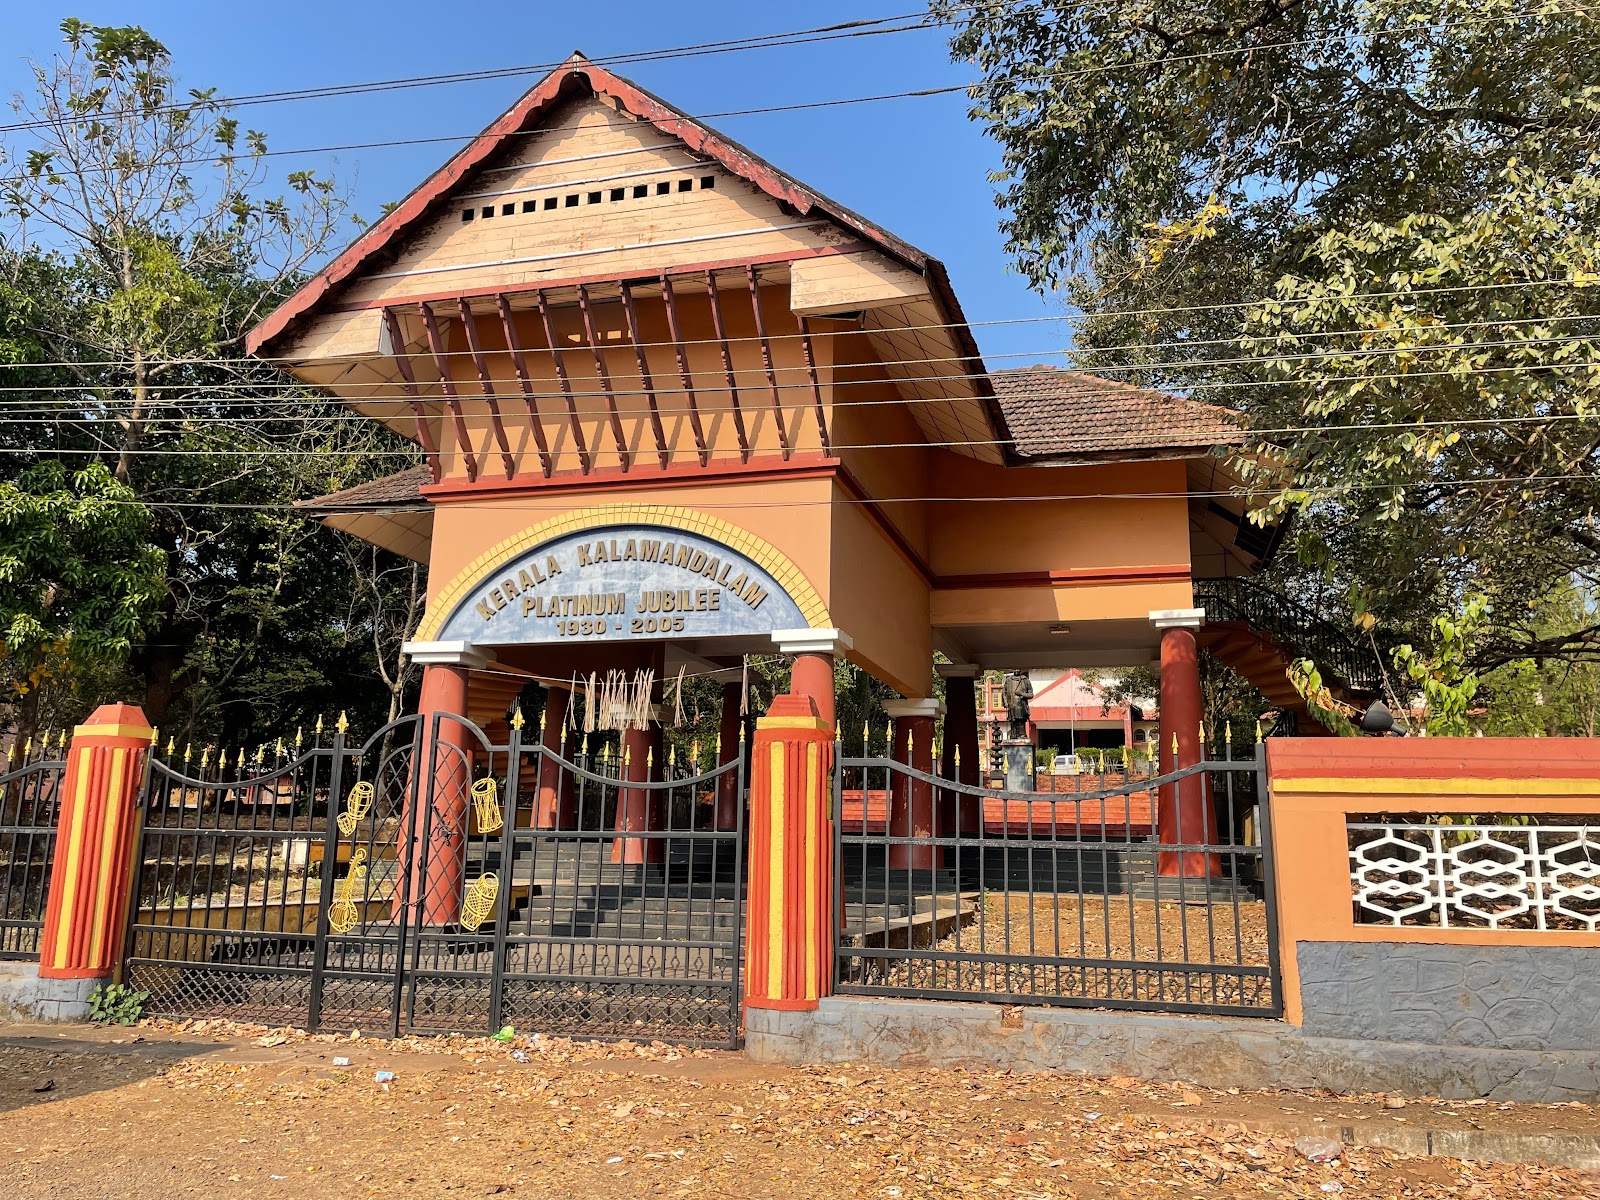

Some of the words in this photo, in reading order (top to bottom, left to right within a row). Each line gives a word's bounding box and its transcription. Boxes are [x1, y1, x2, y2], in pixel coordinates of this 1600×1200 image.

[475, 555, 562, 620] KERALA
[577, 539, 769, 610] KALAMANDALAM
[522, 592, 625, 617] PLATINUM
[636, 589, 720, 613] JUBILEE
[556, 619, 607, 636] 1930
[631, 616, 685, 633] 2005
